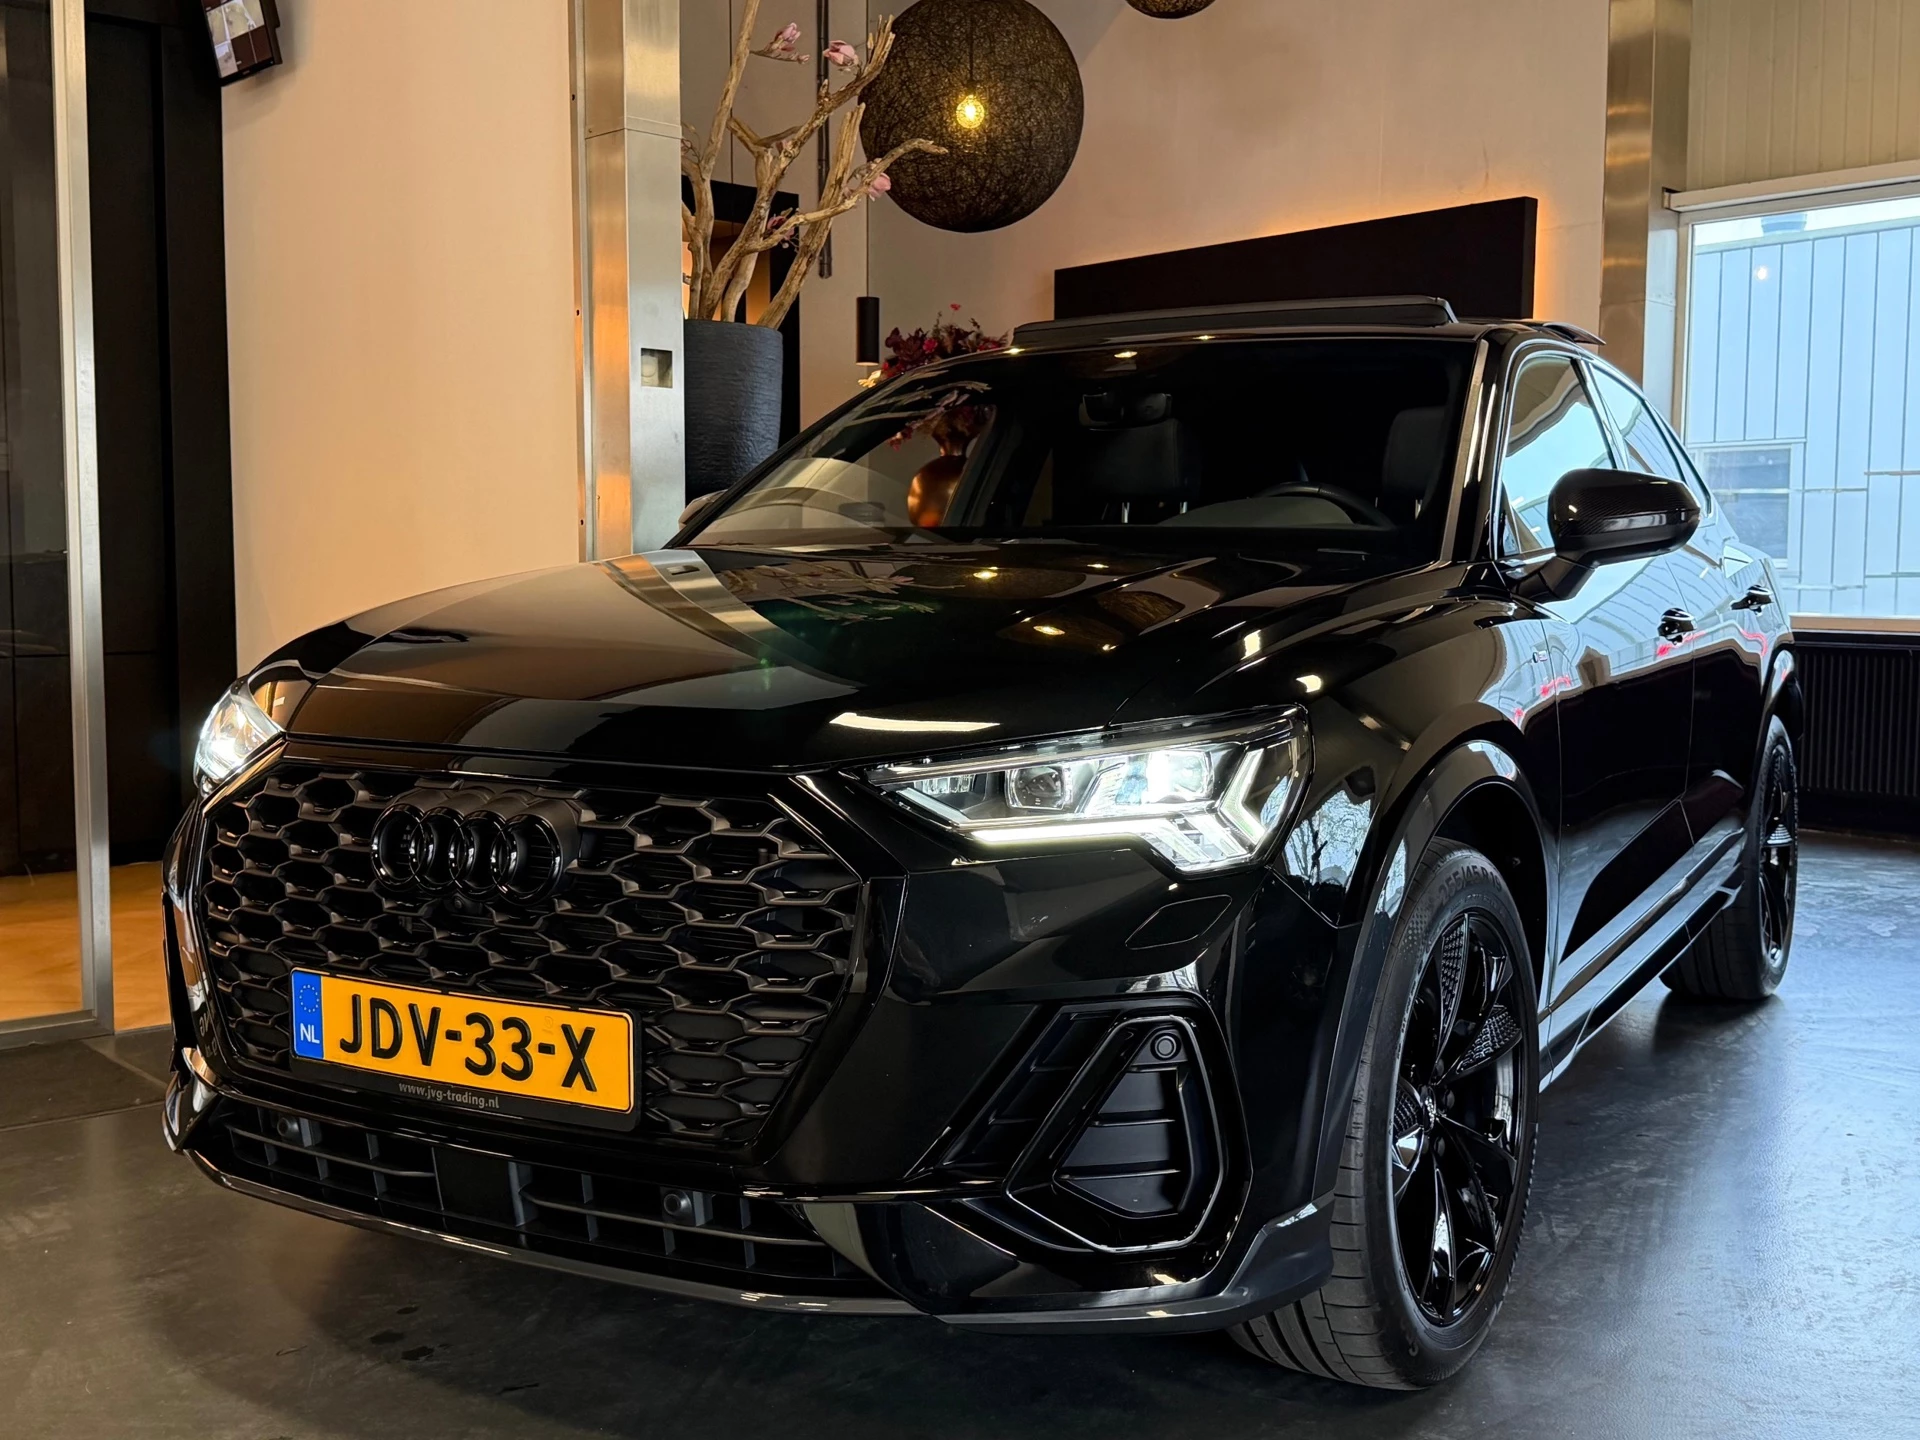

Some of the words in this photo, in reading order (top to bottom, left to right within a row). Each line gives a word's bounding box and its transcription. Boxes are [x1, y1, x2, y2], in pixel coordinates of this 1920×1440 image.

[299, 1022, 321, 1044] NL
[340, 994, 598, 1093] JDV-33-X
[398, 1082, 500, 1109] www.jvg-trading.nl
